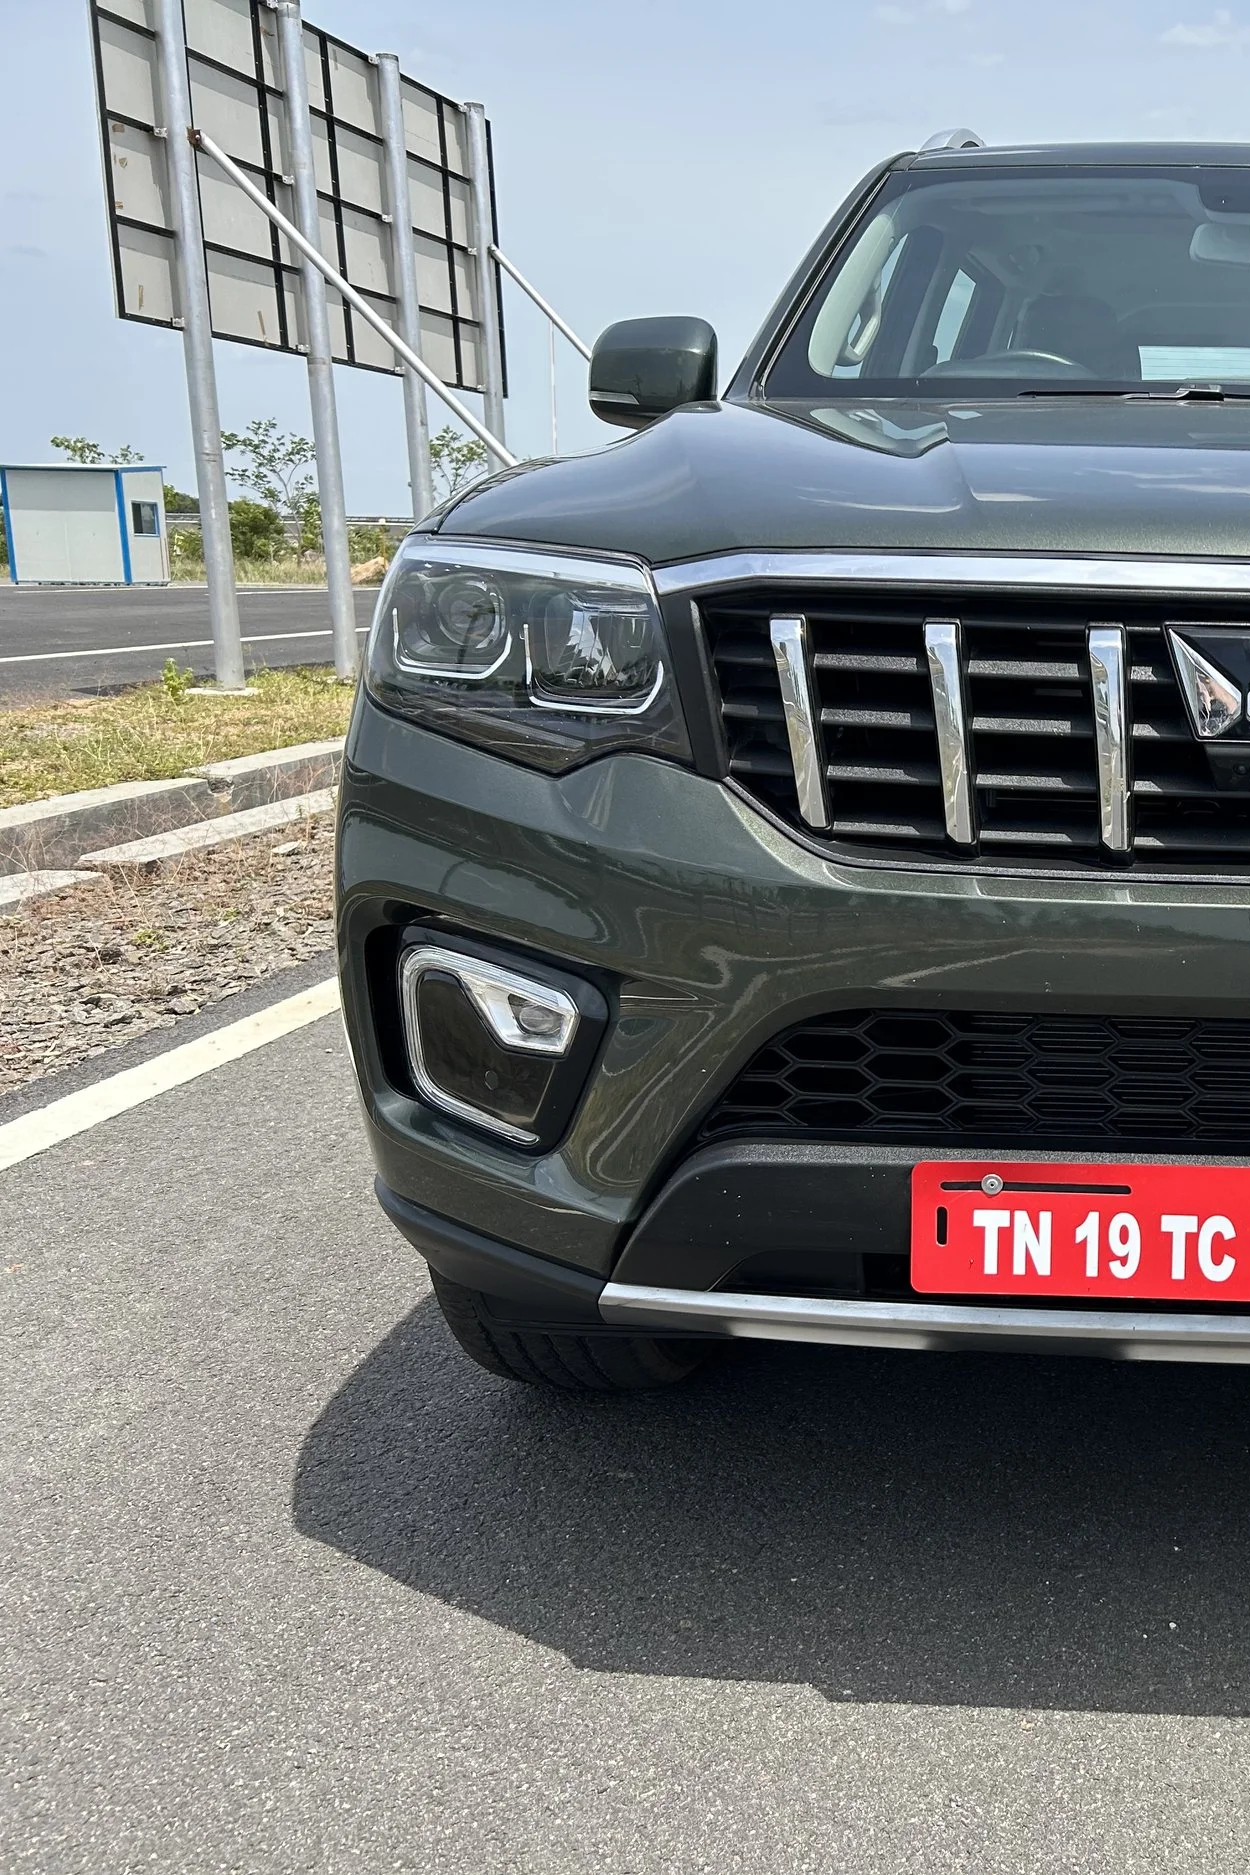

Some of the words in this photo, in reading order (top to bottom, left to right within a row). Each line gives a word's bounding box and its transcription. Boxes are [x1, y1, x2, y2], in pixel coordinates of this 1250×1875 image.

[972, 1209, 1052, 1276] TN
[1075, 1211, 1141, 1280] 19
[1160, 1214, 1237, 1282] TC
